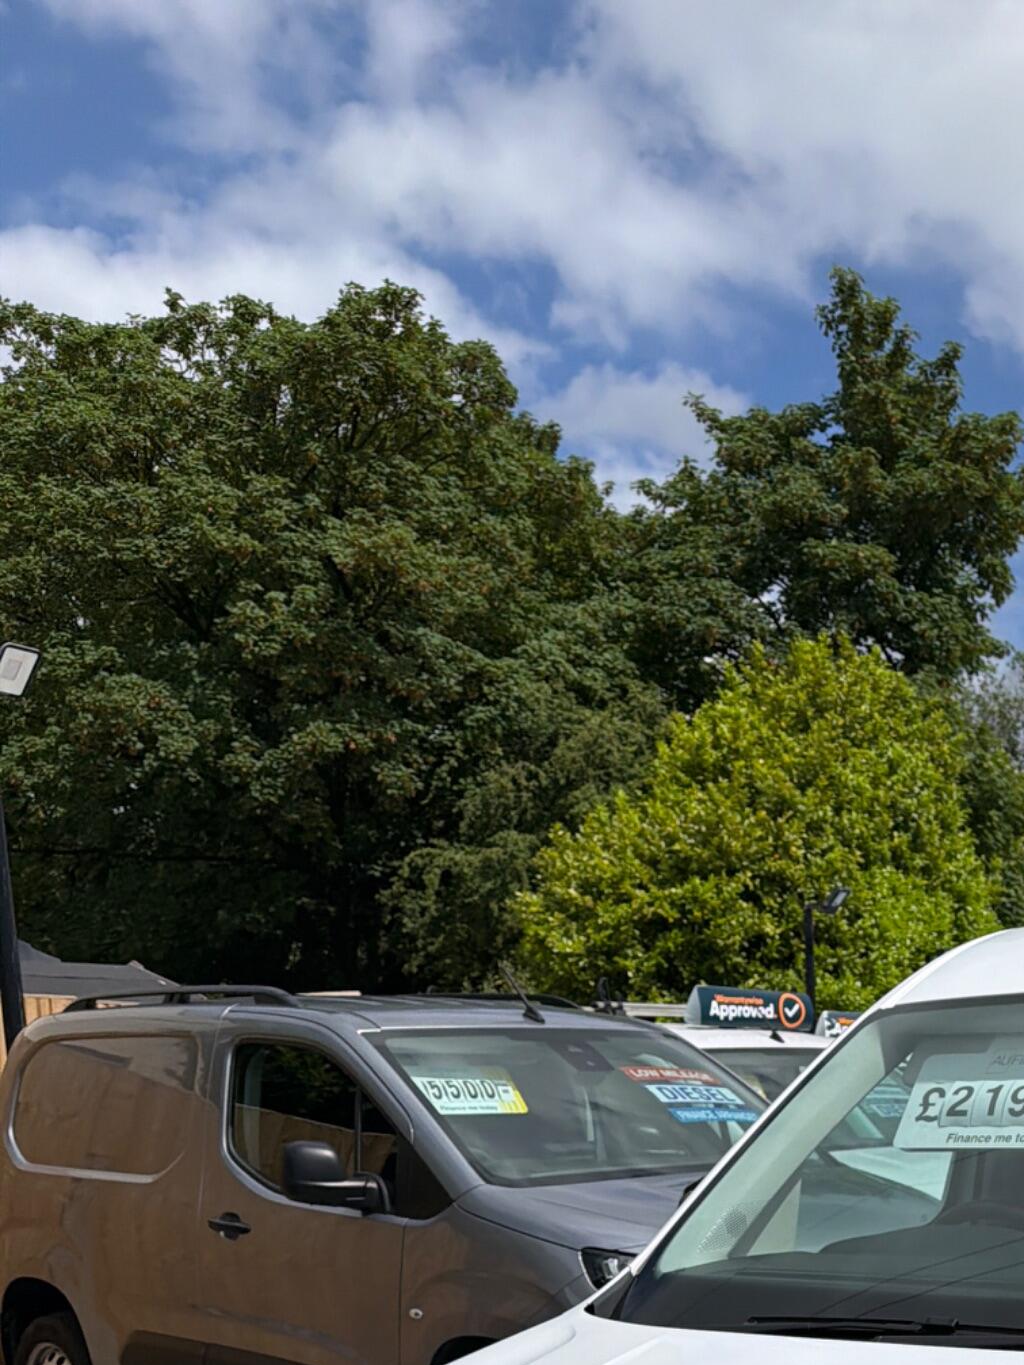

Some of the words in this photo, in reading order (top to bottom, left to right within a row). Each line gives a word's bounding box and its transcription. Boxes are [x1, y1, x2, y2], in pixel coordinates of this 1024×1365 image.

[655, 1086, 738, 1102] DIESEL
[946, 1132, 992, 1144] Finance
[993, 1135, 1013, 1144] me
